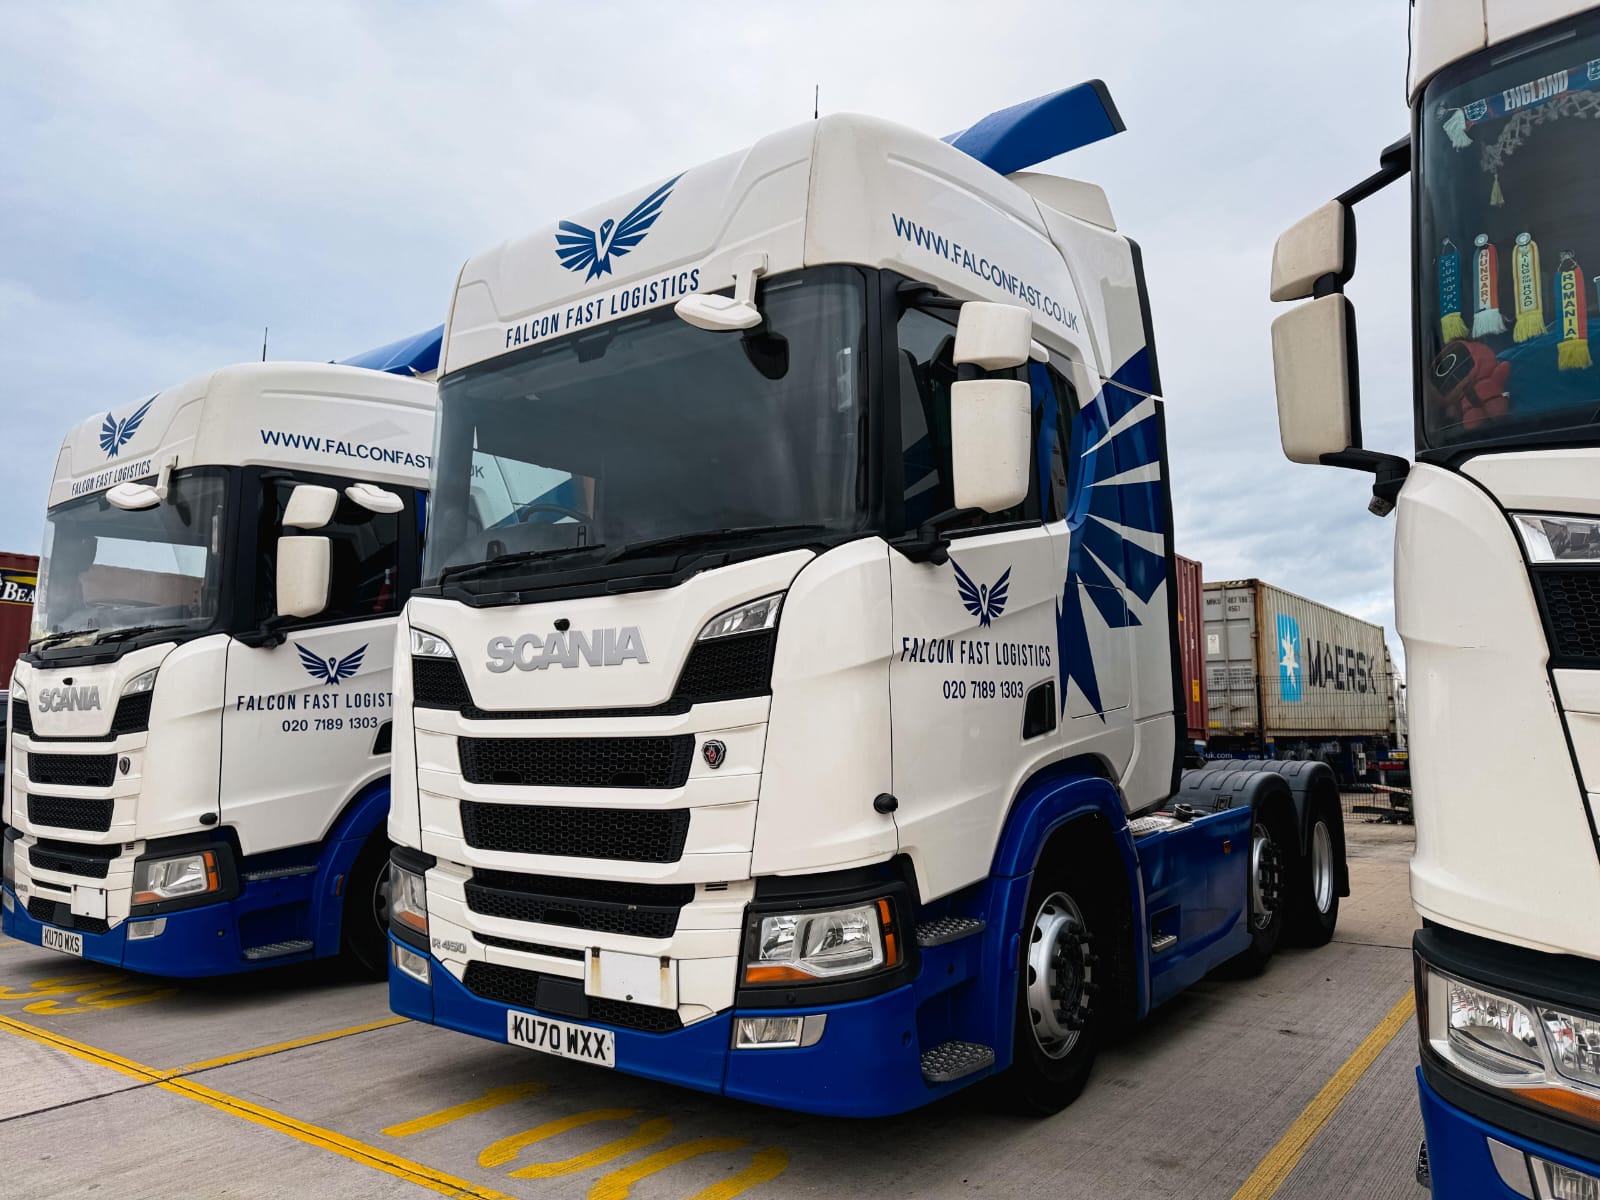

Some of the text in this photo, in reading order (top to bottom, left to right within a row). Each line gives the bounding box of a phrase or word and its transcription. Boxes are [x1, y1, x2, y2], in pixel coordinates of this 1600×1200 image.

[1503, 70, 1568, 111] ENGLAND
[892, 213, 1079, 333] WWW.FALCONFAST.CO.UK
[1480, 253, 1489, 305] HUNGARY
[505, 269, 700, 348] FALCON FAST LOGISTICS
[1563, 274, 1576, 336] ROMANIA
[71, 460, 151, 496] FALCON FAST LOGISTICS
[486, 626, 650, 674] SCANIA
[900, 637, 1051, 667] FALCON FAST LOGISTICS
[1307, 637, 1376, 694] MAERSK
[39, 685, 102, 713] SCANIA
[237, 694, 296, 711] FALCON
[304, 693, 339, 709] FAST
[943, 680, 1024, 699] 020 7189 1303
[282, 717, 378, 732] 020 7189 1303
[45, 927, 80, 953] KU70 WXS
[513, 1015, 606, 1061] KU70 WXX
